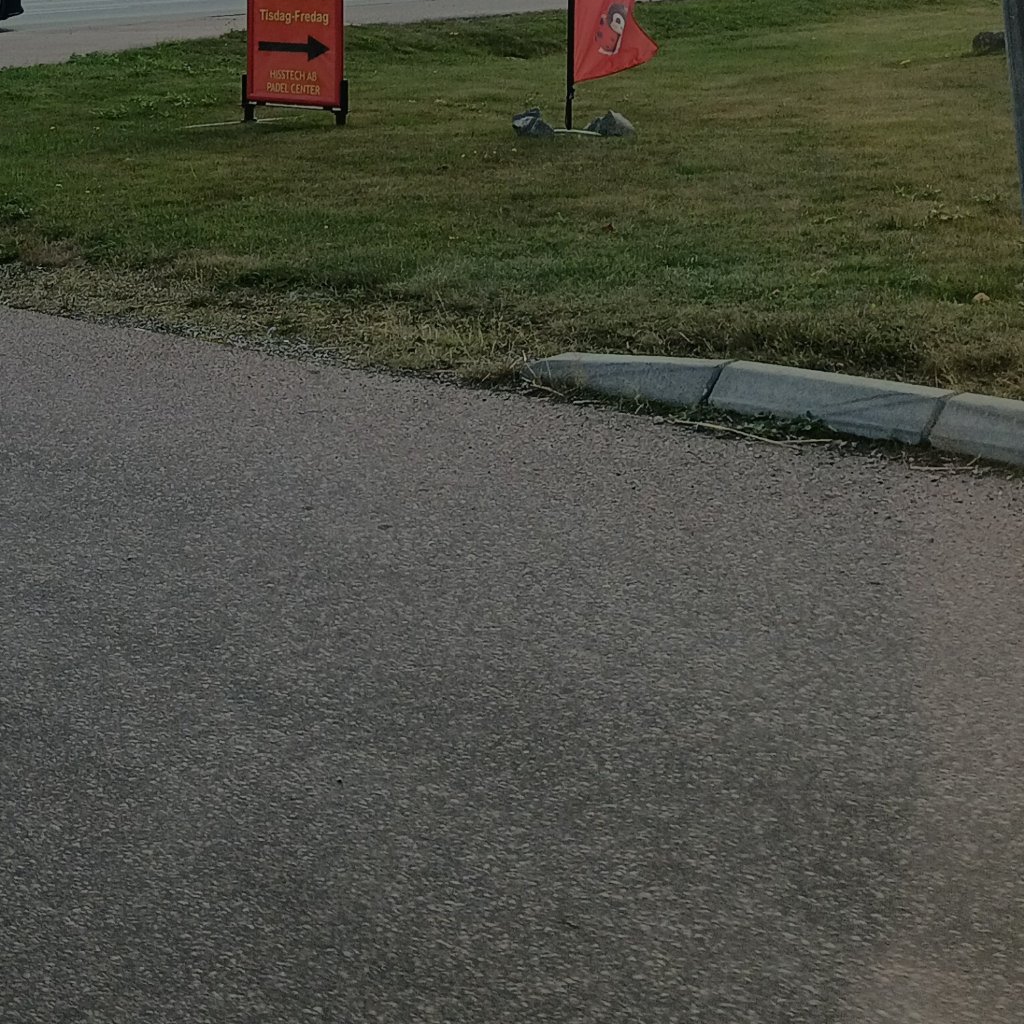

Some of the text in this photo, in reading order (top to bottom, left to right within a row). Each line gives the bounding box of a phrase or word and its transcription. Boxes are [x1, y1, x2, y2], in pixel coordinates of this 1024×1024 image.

[259, 9, 329, 26] Tisdag-Fredag
[270, 70, 317, 82] HISSTECH AB
[266, 82, 320, 95] PADEL CENTER
